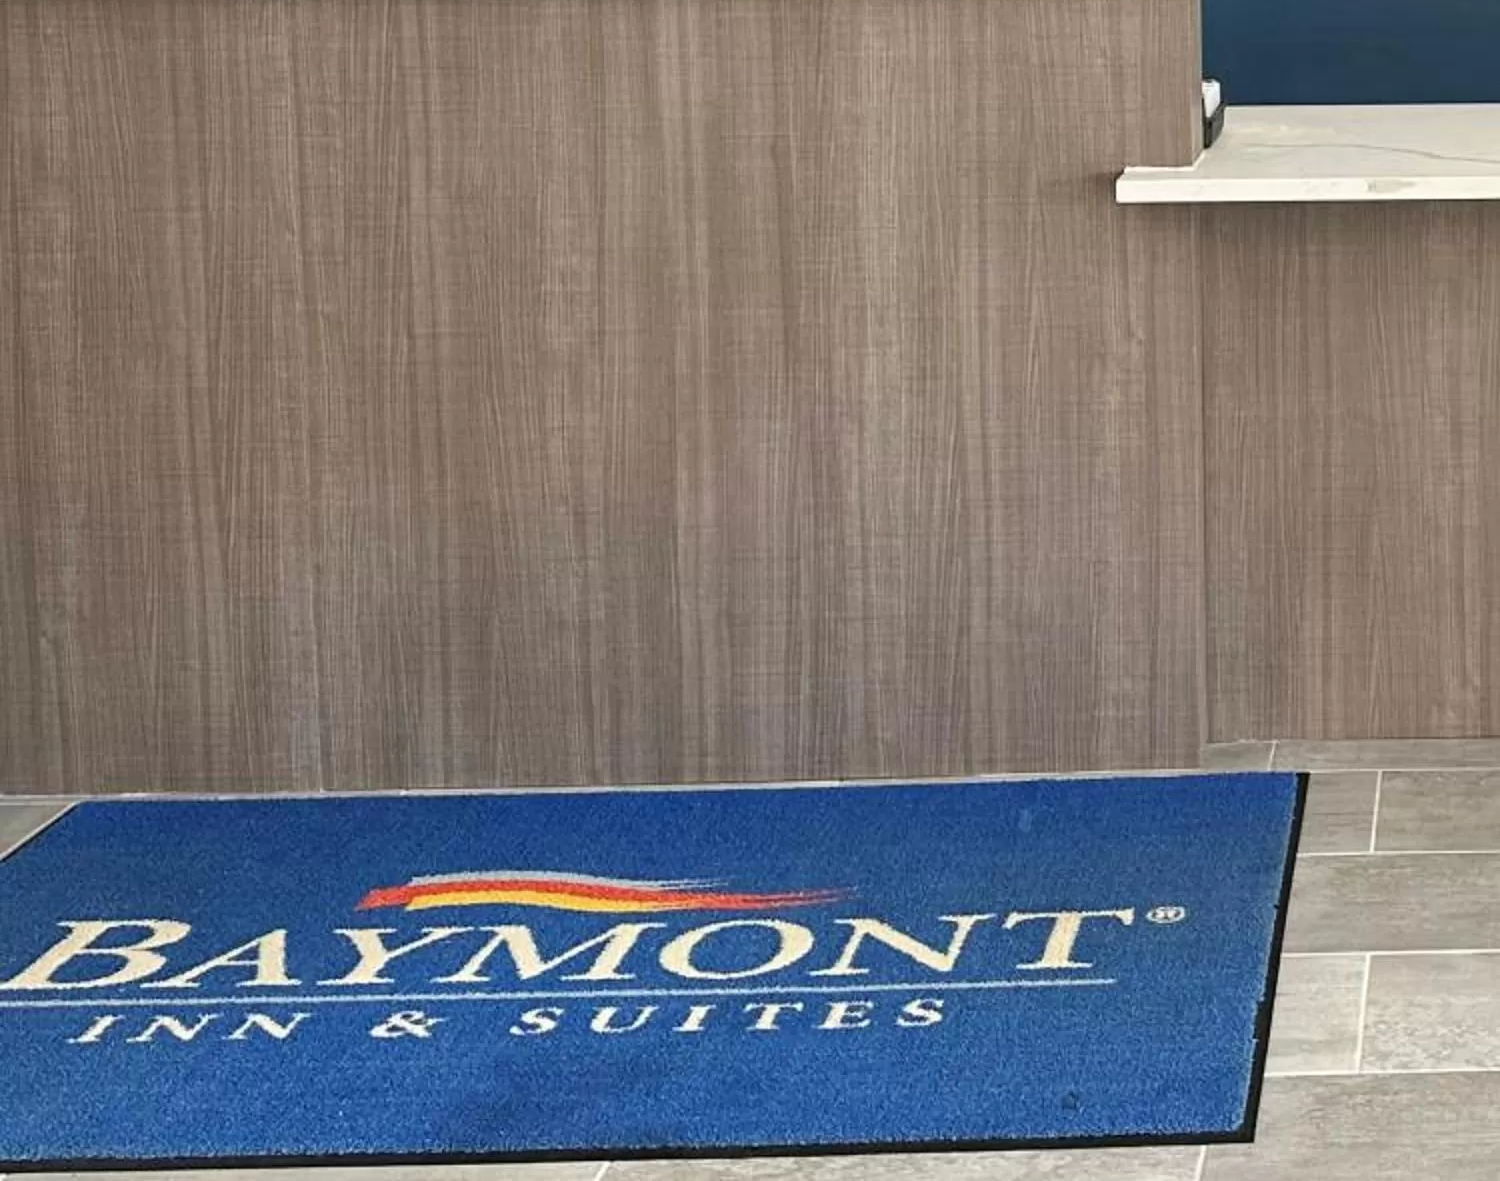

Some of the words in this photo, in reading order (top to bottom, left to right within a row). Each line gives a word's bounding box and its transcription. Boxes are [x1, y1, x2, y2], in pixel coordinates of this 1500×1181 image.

[67, 1012, 312, 1044] INN
[369, 1010, 443, 1040] &
[510, 997, 946, 1038] SUITES
